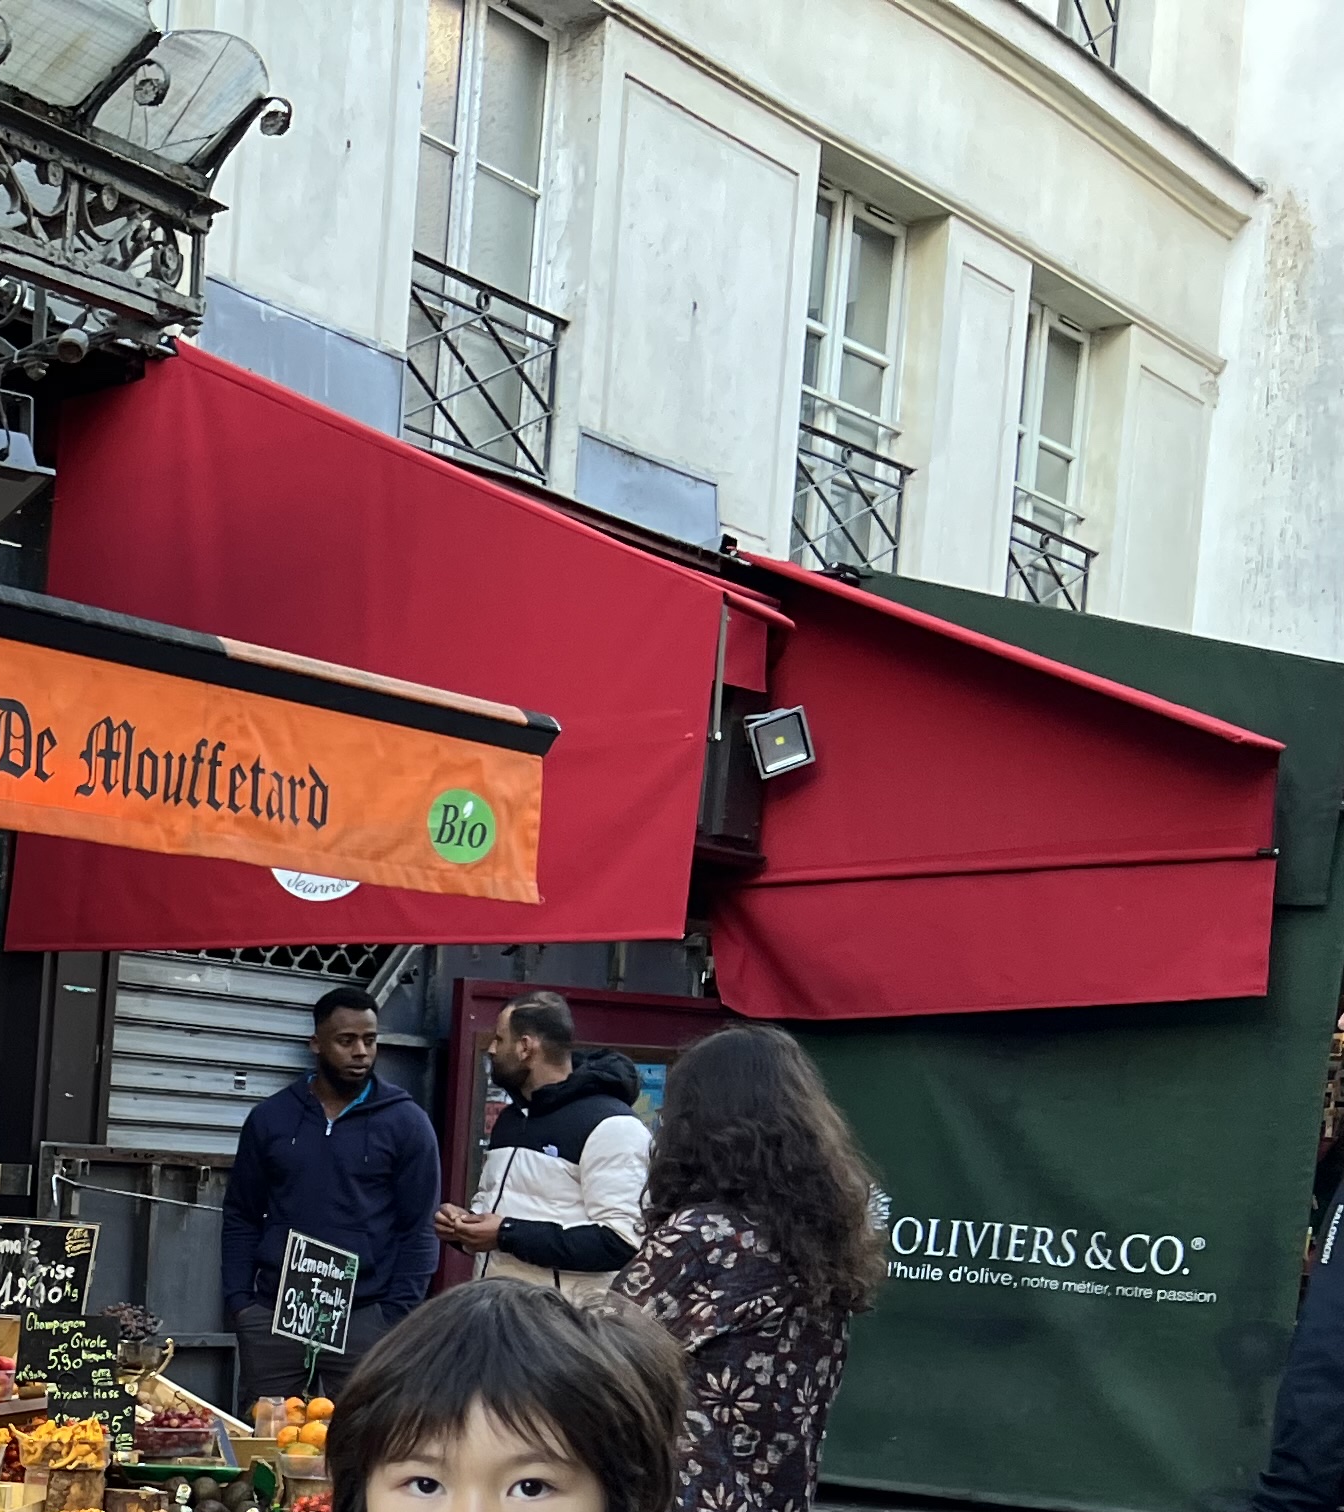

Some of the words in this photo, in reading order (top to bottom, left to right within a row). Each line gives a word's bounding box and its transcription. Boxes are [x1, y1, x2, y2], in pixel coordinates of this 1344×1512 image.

[74, 715, 329, 831] Mouffetard
[434, 801, 490, 851] Bio
[949, 1264, 1018, 1288] d'olive,
[1021, 1276, 1061, 1291] notre
[1116, 1284, 1153, 1300] notre
[1156, 1286, 1217, 1303] passion
